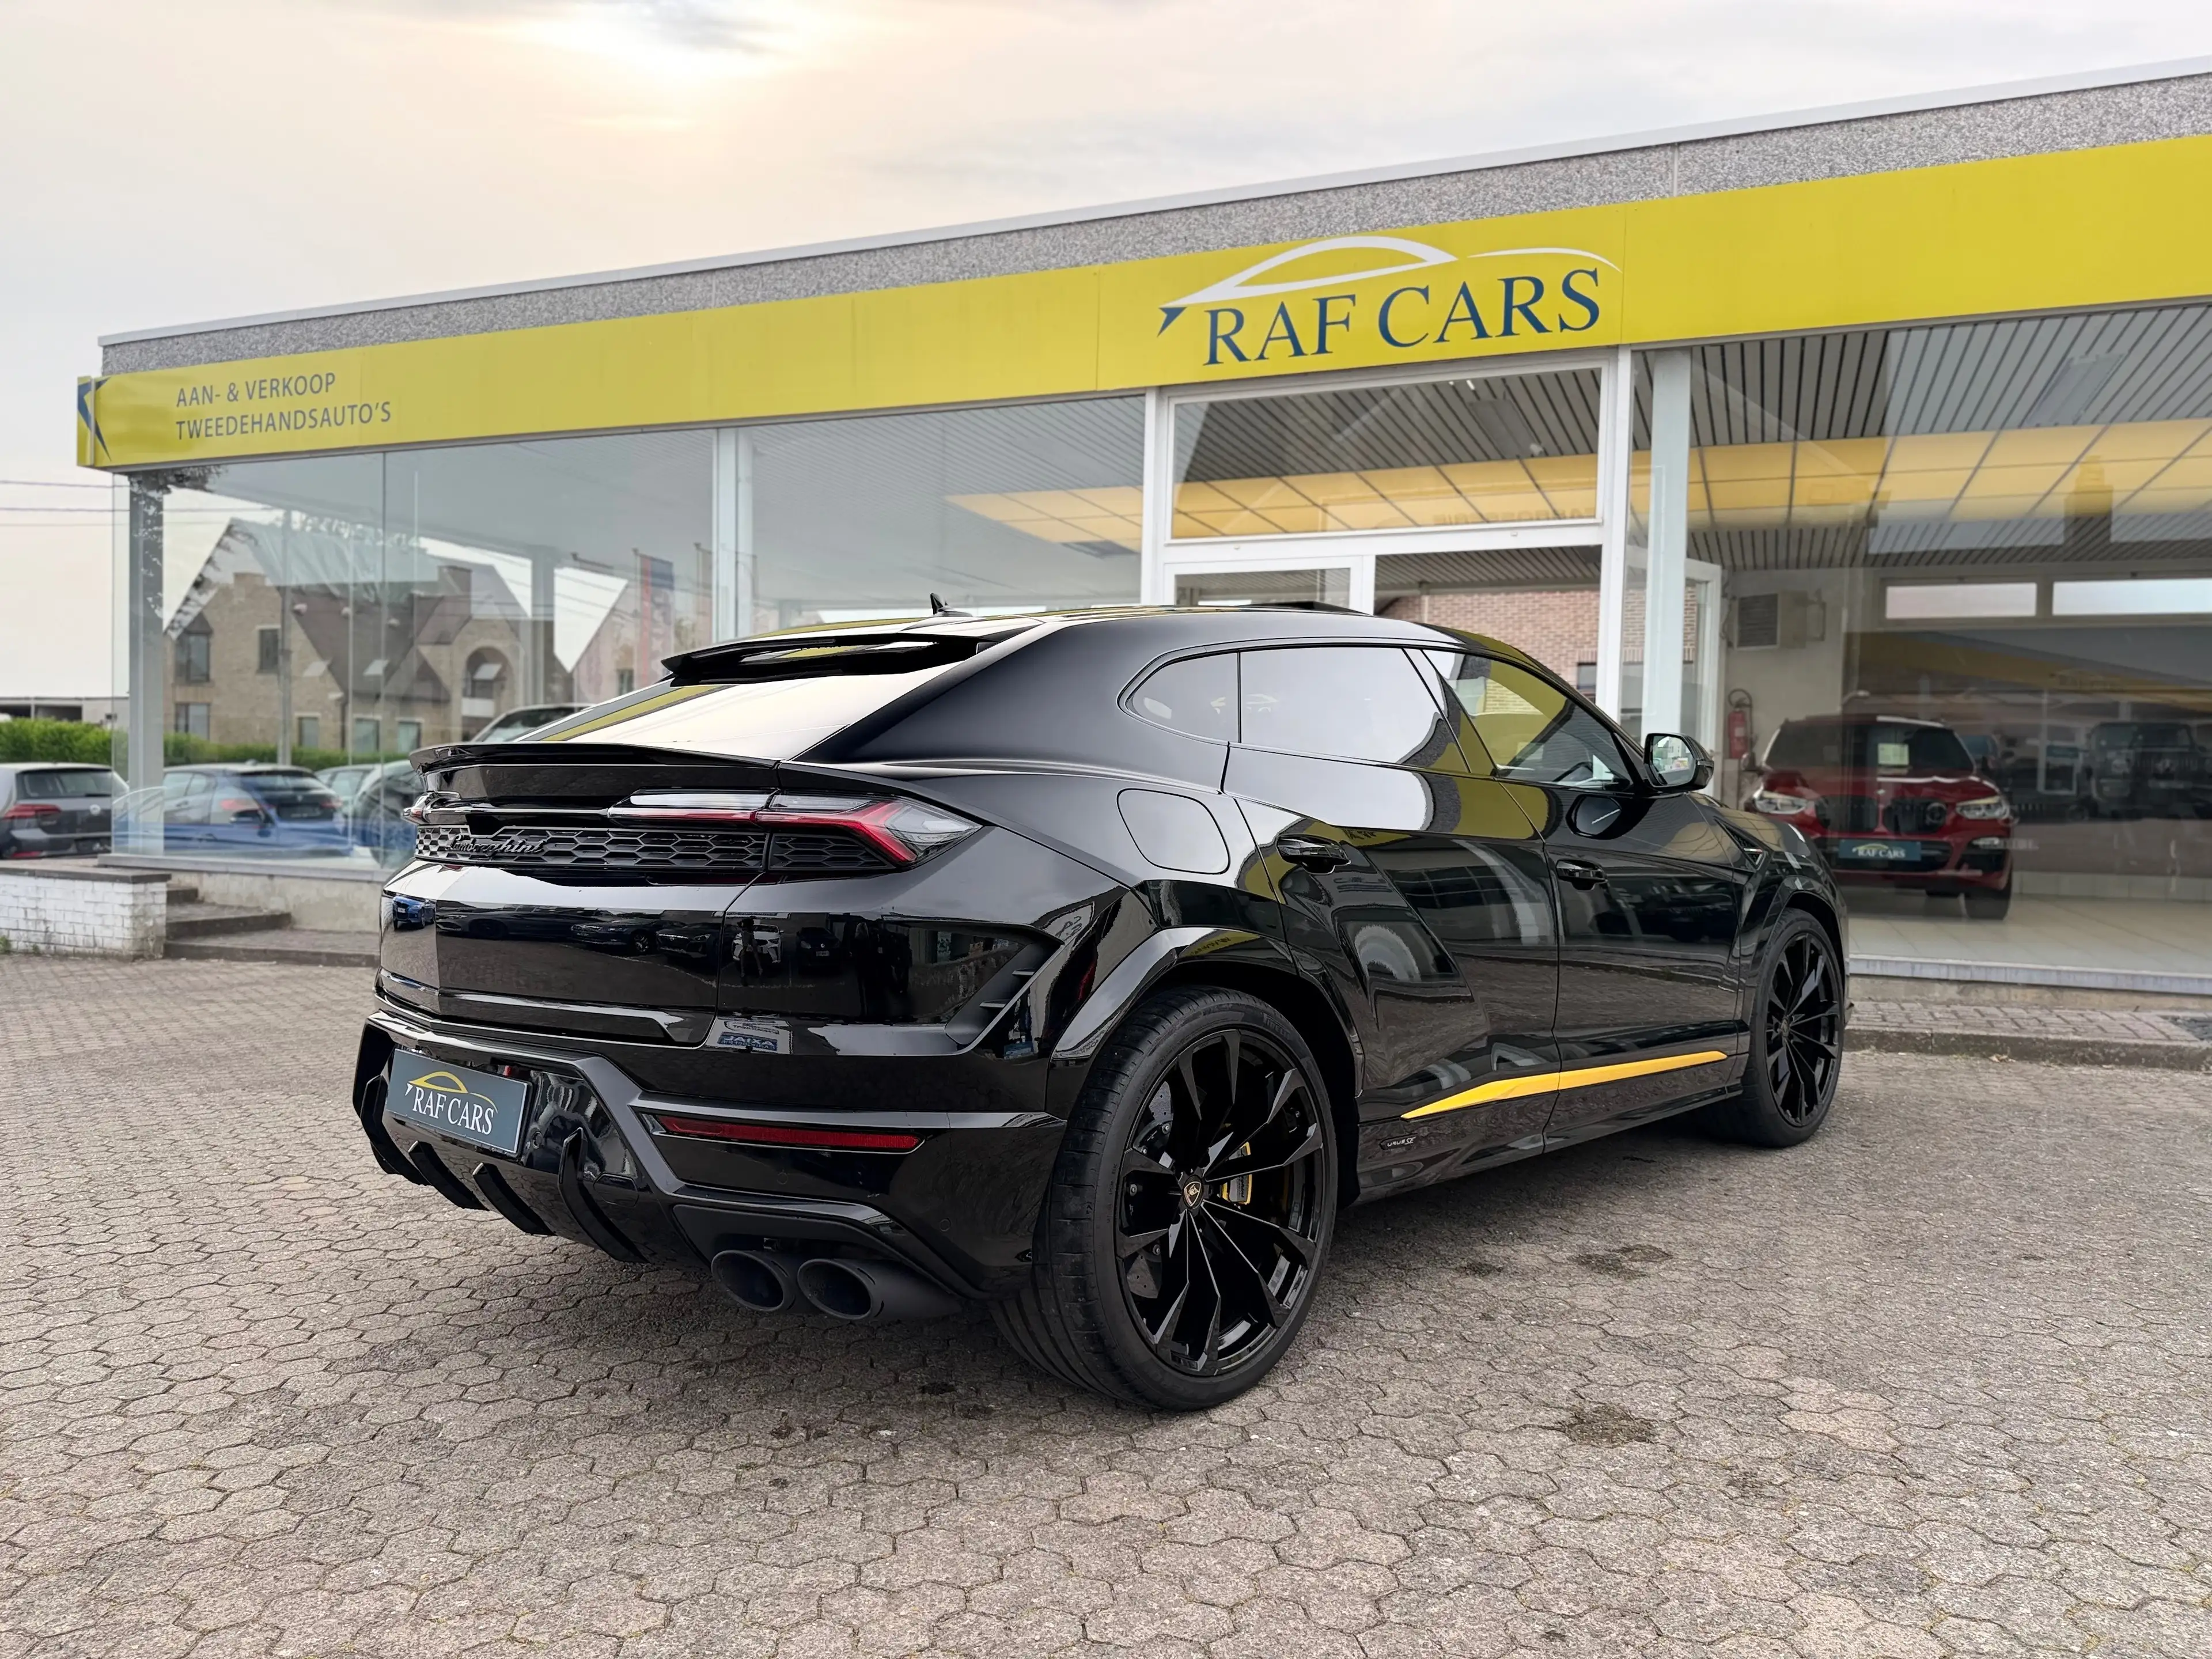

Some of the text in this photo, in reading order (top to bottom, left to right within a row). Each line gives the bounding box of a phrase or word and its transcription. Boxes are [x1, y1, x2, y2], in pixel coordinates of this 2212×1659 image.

[1203, 267, 1600, 366] RAF CARS
[176, 372, 335, 408] AAN- & VERKOOP
[176, 401, 391, 440] TWEEDEHANDSAUTO'S
[445, 834, 546, 856] Lamborghini
[1857, 849, 1906, 859] RAF CARS
[412, 1086, 494, 1135] RAF CARS
